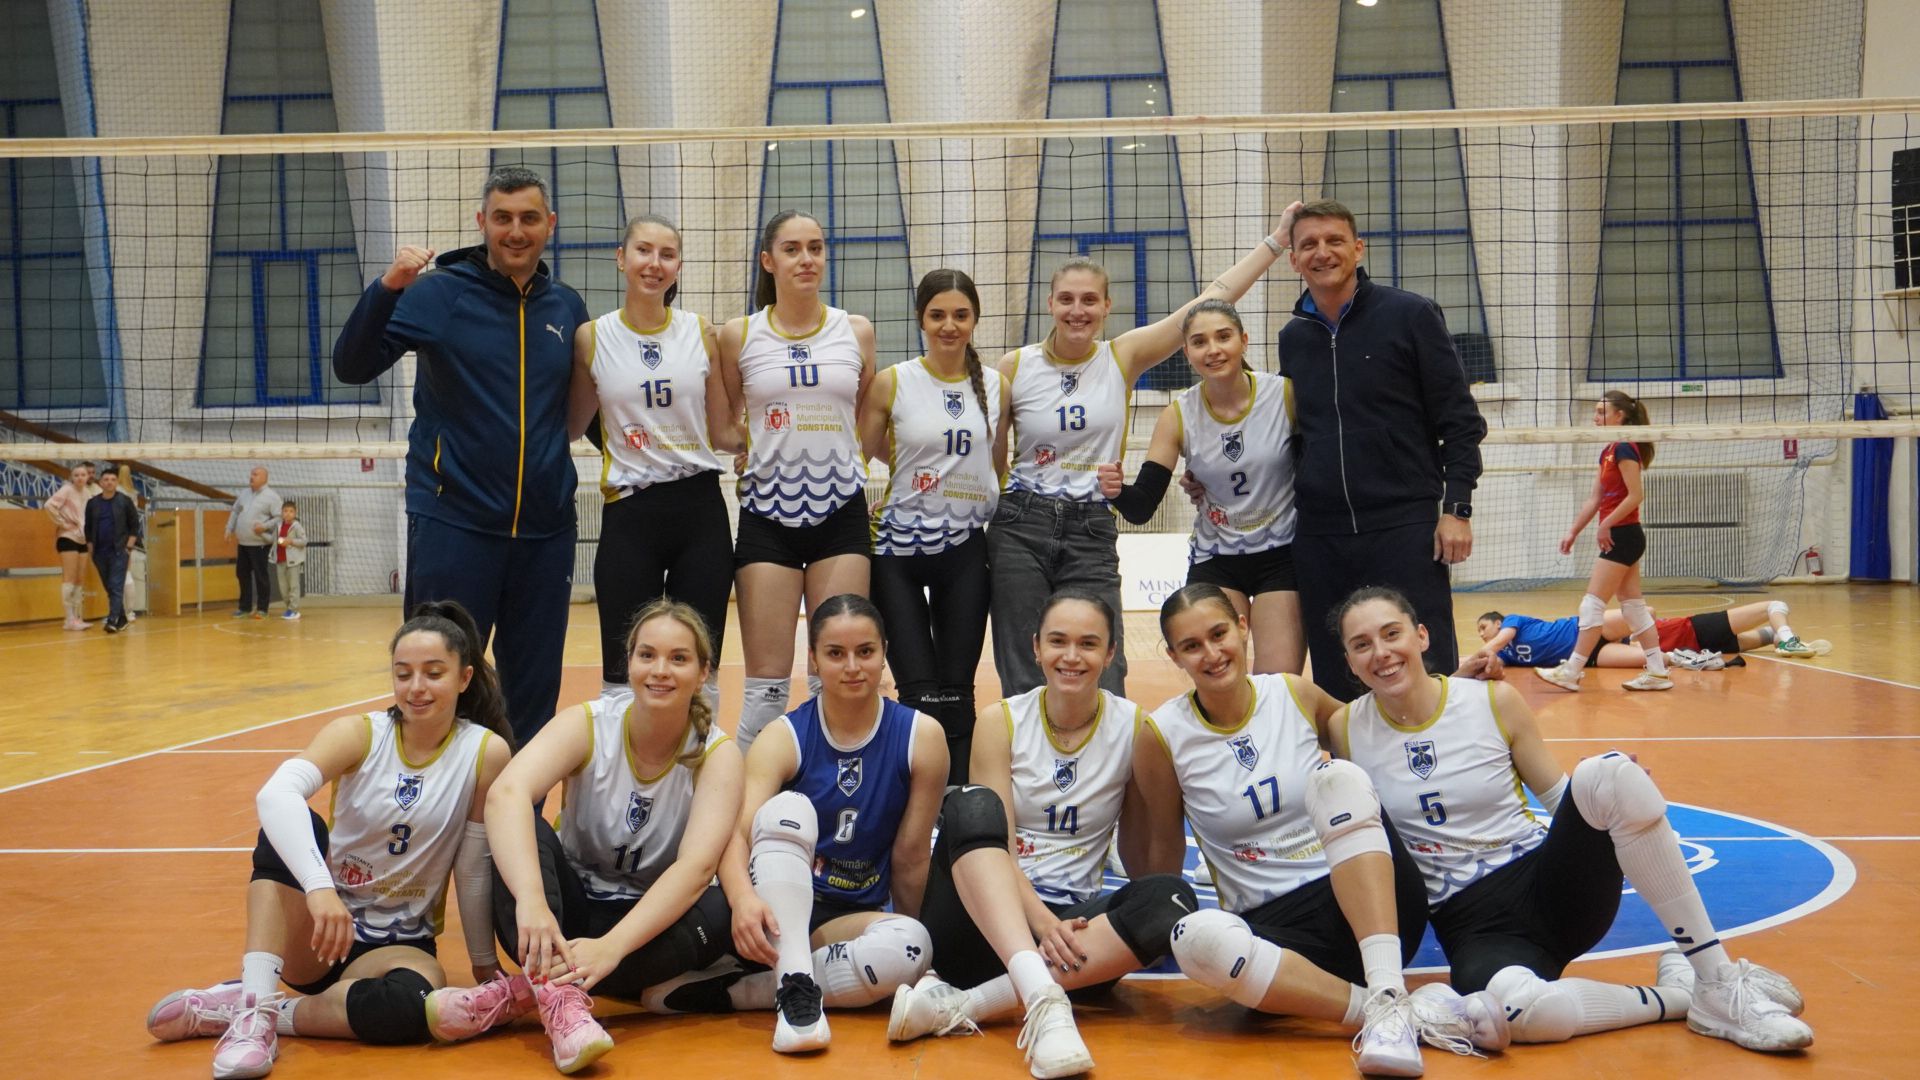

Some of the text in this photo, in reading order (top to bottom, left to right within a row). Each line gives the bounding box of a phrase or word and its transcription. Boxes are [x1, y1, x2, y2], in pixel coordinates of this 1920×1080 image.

[784, 364, 819, 388] 10
[640, 379, 672, 409] 15
[1056, 405, 1086, 431] 13
[943, 429, 972, 456] 16
[1231, 472, 1250, 496] 2
[1139, 580, 1182, 591] MINI
[1516, 645, 1532, 662] 20
[1243, 776, 1280, 820] 17
[1419, 792, 1447, 826] 5
[834, 808, 859, 842] 6
[1044, 805, 1079, 835] 14
[388, 824, 411, 855] 3
[614, 845, 643, 873] 11
